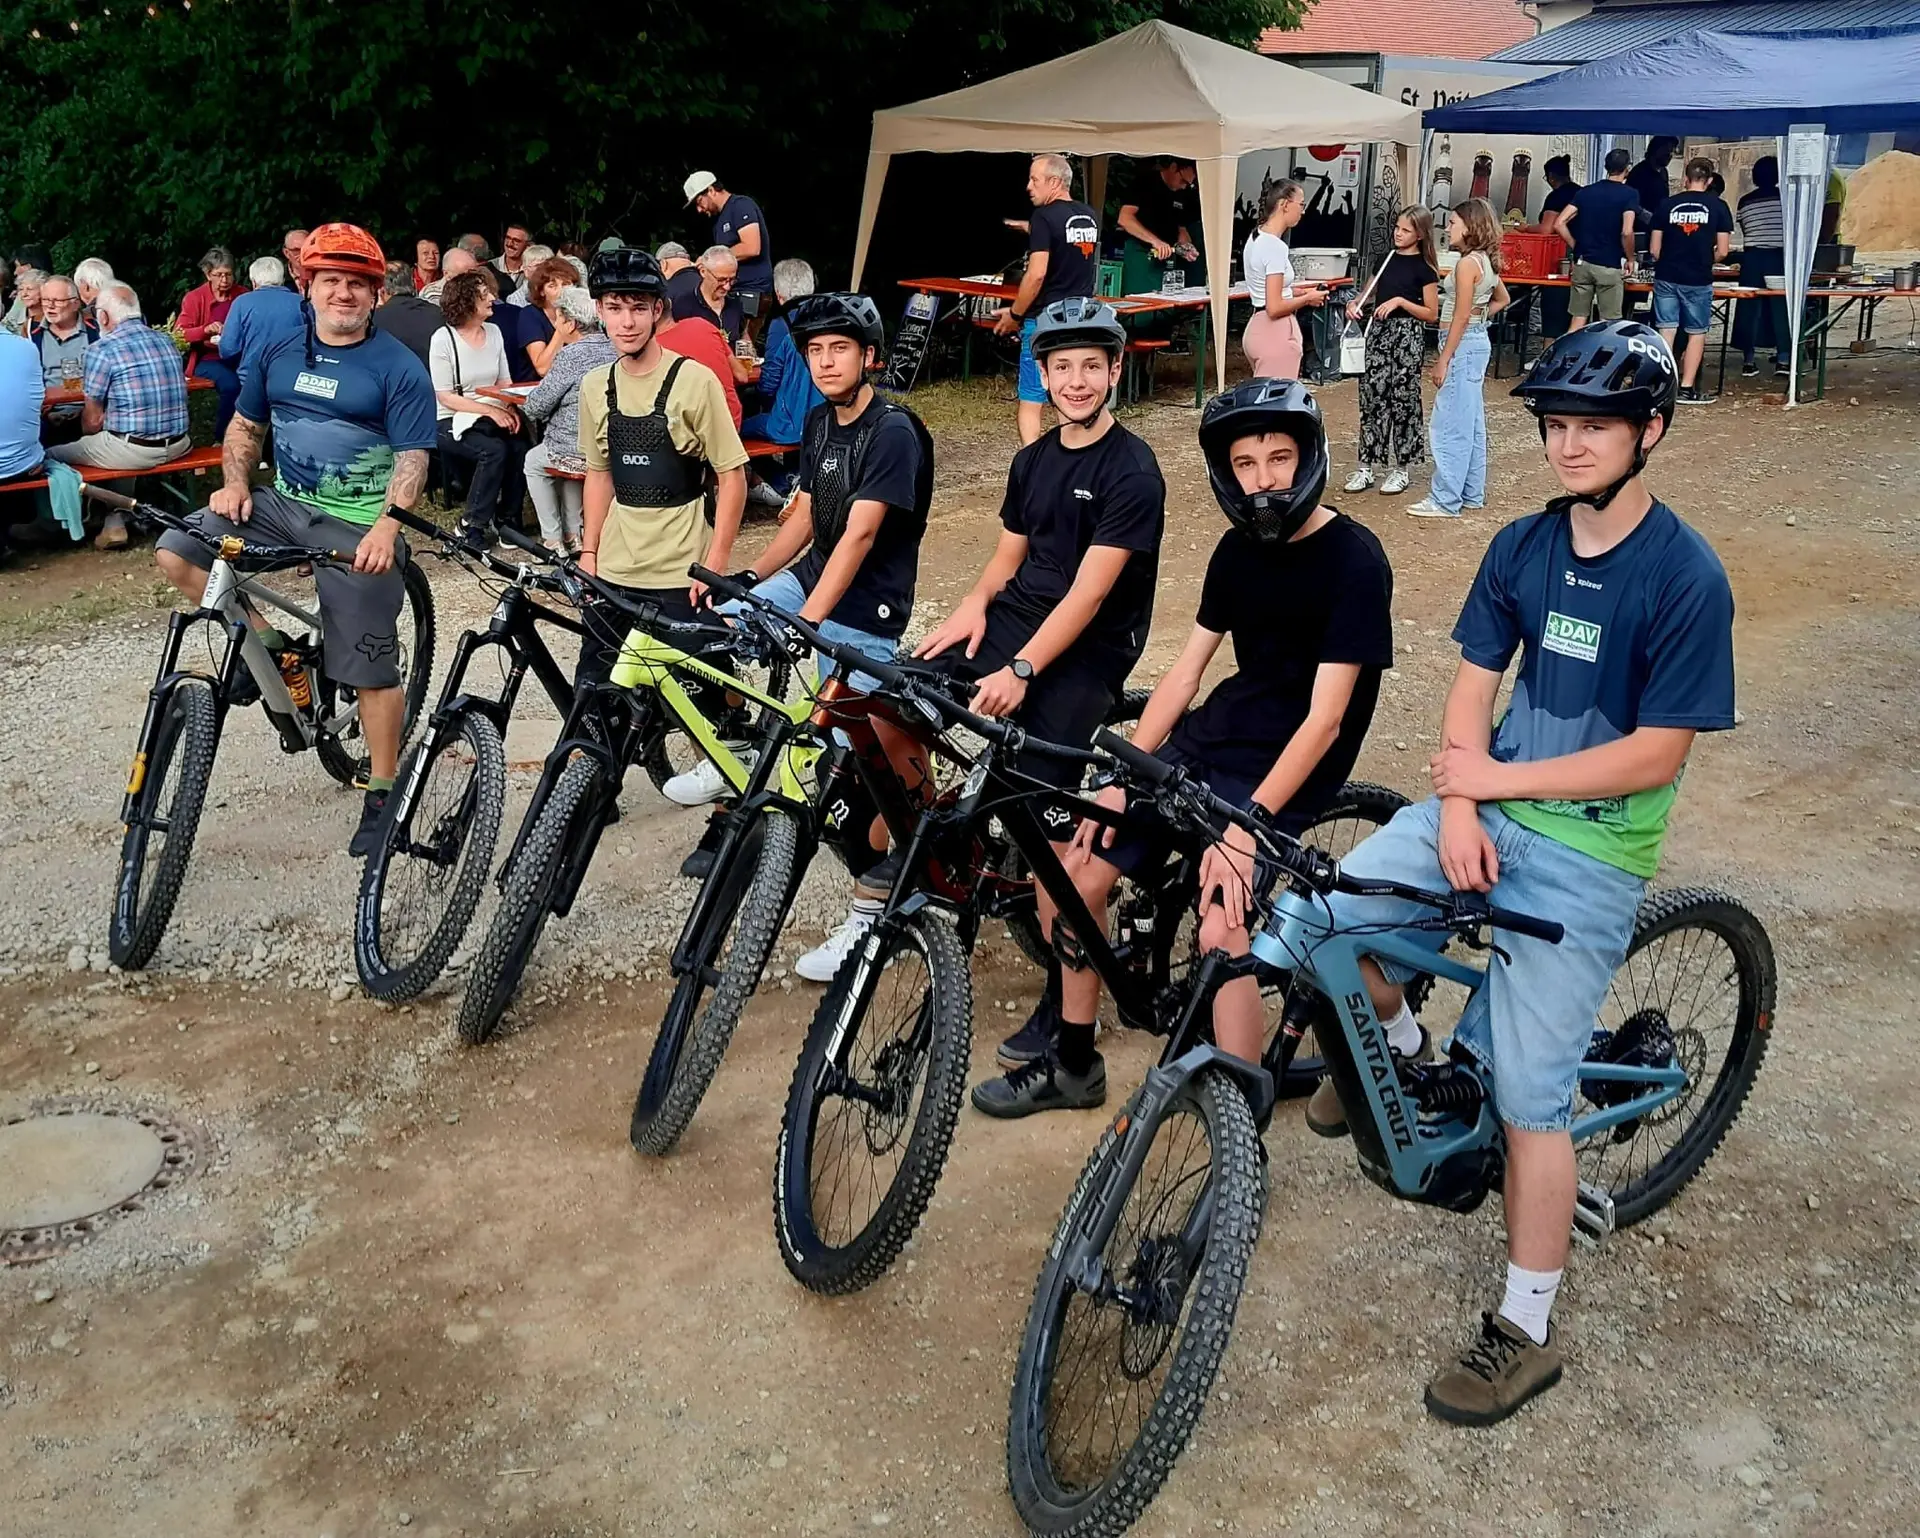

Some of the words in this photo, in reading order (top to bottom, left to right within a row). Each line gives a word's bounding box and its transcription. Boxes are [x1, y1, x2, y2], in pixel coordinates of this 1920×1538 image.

[1627, 338, 1673, 375] POC
[308, 378, 336, 390] DAV
[1577, 579, 1603, 591] spized
[1559, 620, 1598, 644] DAV
[684, 661, 724, 687] TORQUE
[1345, 991, 1389, 1086] SANTA
[1378, 1084, 1414, 1153] CRUZ
